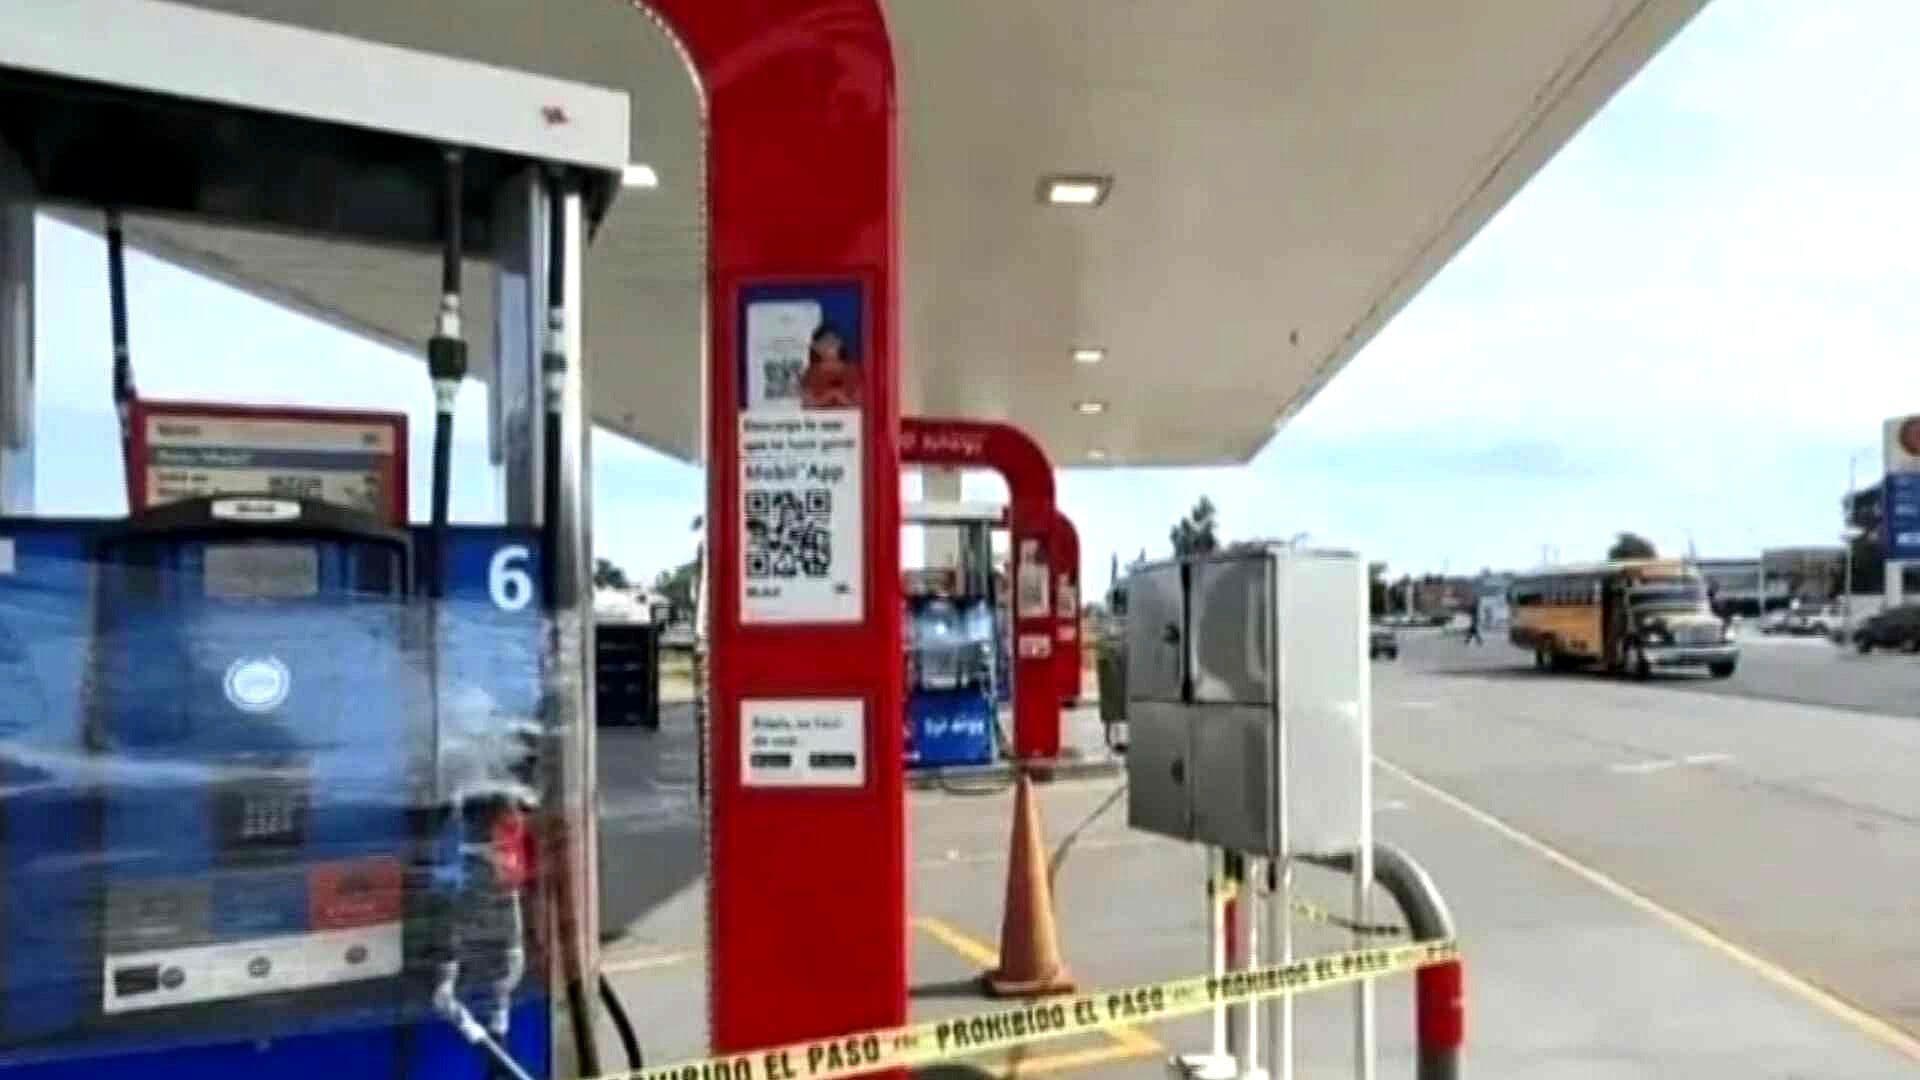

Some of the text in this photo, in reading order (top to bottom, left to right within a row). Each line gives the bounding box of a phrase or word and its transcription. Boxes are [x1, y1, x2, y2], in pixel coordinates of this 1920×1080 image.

[807, 462, 844, 484] App
[488, 545, 532, 612] 6
[764, 1053, 796, 1080] EL
[807, 1035, 880, 1074] PASO
[936, 1003, 1066, 1052] PROHIBIDO
[1075, 1000, 1098, 1026] EL
[1107, 987, 1164, 1020] PASO
[1206, 963, 1308, 1001] PROHIBIDO
[1314, 958, 1335, 981] EL
[1341, 951, 1390, 975] PASO
